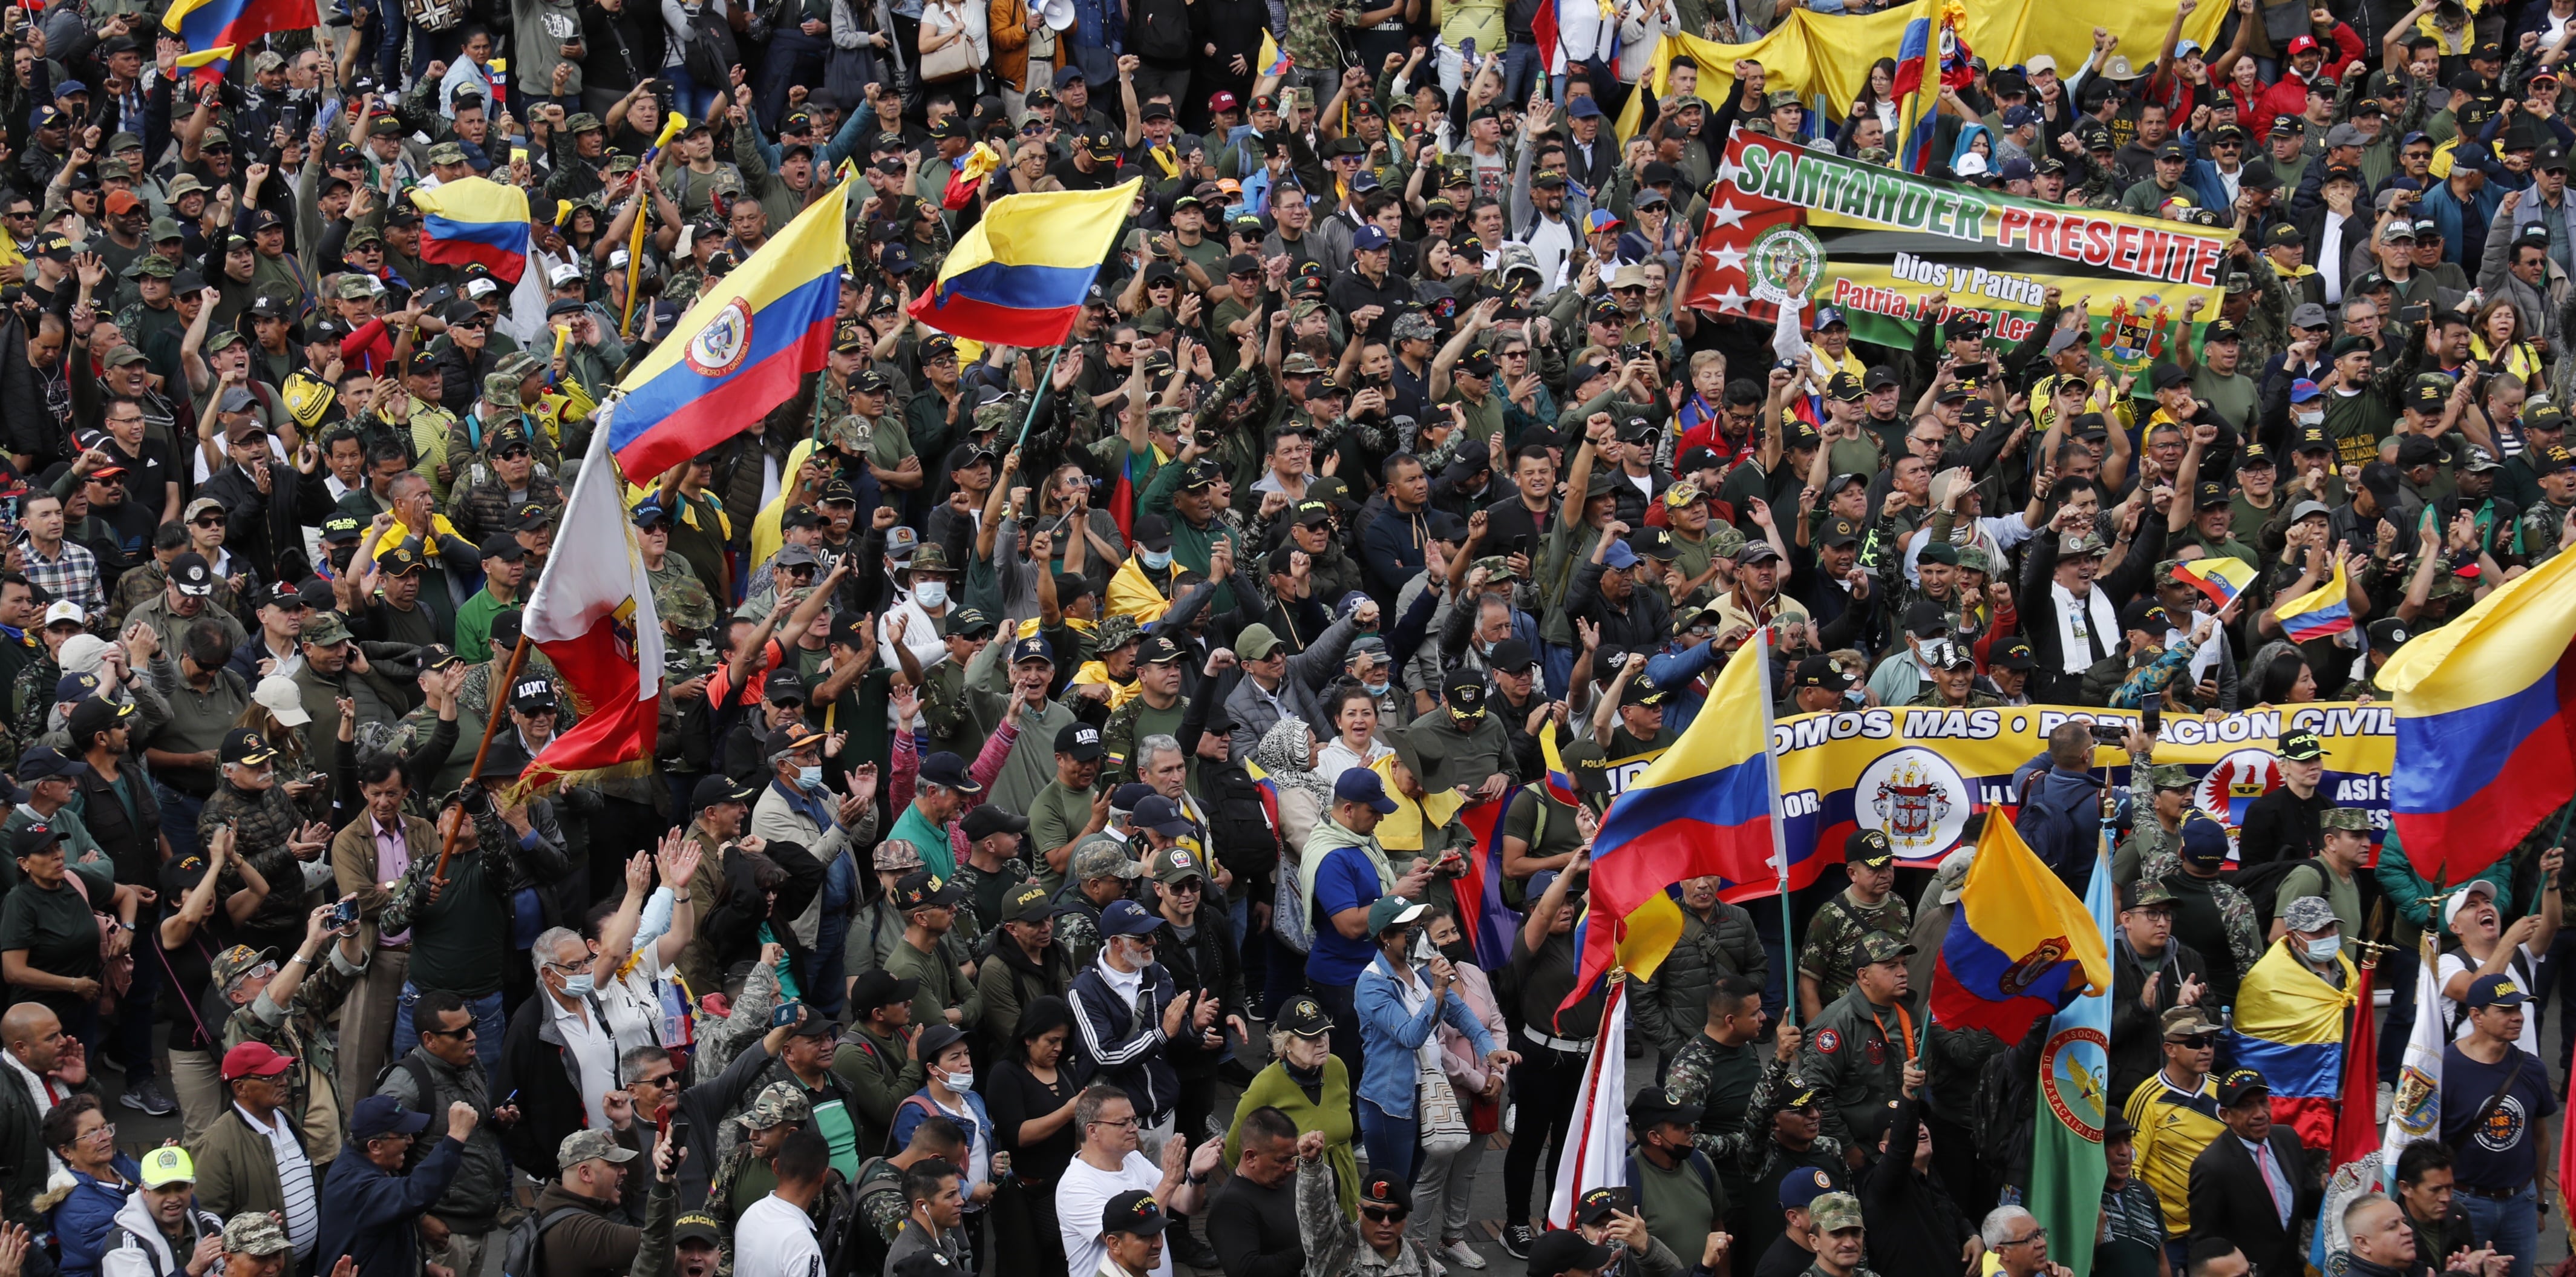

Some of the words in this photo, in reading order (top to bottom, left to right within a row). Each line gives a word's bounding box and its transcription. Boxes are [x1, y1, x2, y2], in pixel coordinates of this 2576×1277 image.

[1734, 143, 1989, 243] SANTANDER
[1996, 204, 2223, 289] PRESENTE
[2388, 222, 2411, 233] ARMY
[1891, 251, 1948, 288] Dios
[1949, 267, 1969, 294] y
[1969, 266, 2045, 307] Patria
[1832, 276, 1912, 321] Patria,
[520, 504, 544, 516] VETERANO
[849, 620, 865, 631] VETER
[518, 680, 547, 698] ARMY
[1903, 709, 2001, 740] MAS
[2292, 707, 2396, 737] CIVIL
[1074, 727, 1100, 744] ARMY
[1981, 785, 1998, 804] LA
[2336, 773, 2377, 801] ASÍ
[2042, 1055, 2052, 1070] DE
[2224, 1068, 2258, 1086] VETERANO
[2044, 1080, 2105, 1140] PARACAIDISTAS
[675, 1214, 718, 1229] POLICIA
